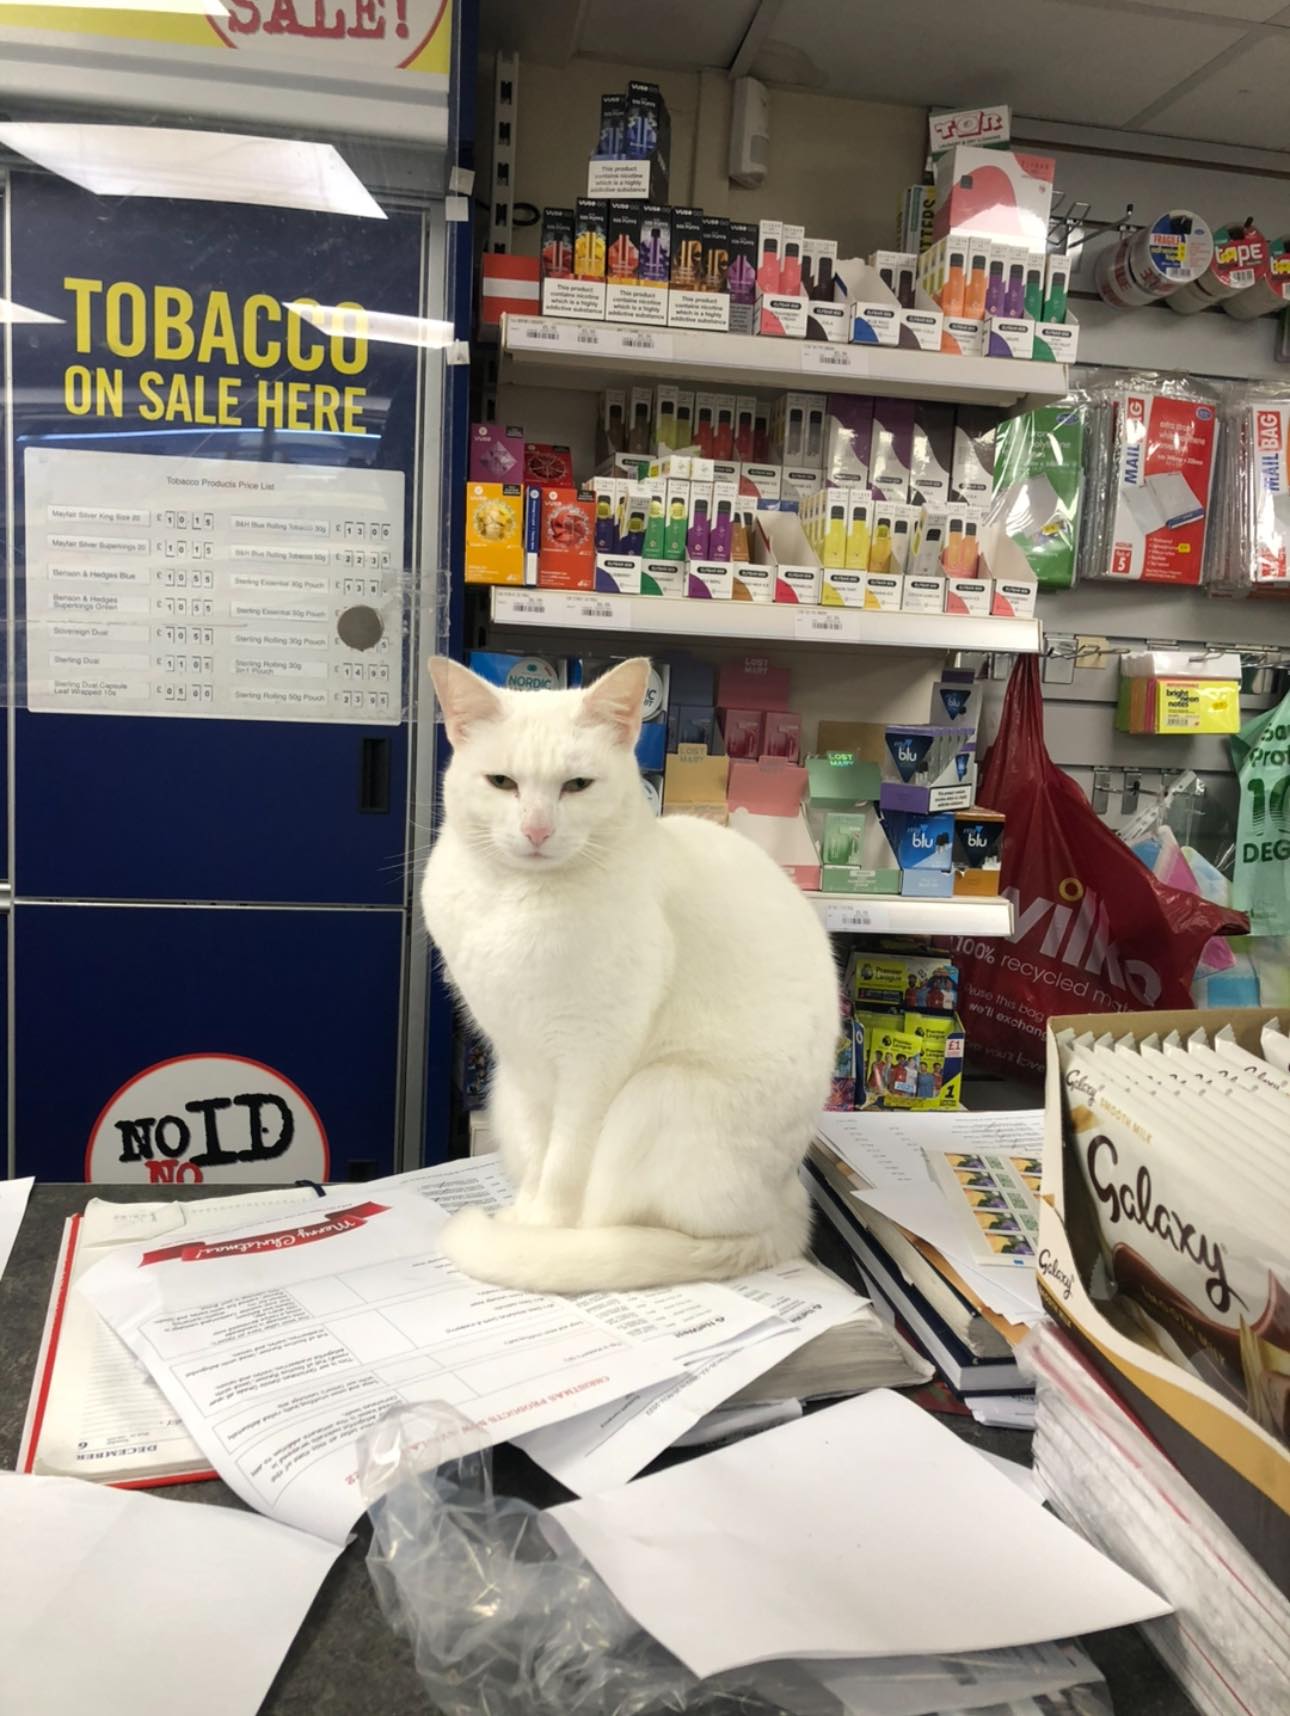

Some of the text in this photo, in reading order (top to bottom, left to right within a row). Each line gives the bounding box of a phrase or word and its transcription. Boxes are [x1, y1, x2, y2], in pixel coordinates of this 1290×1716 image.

[227, 0, 409, 40] SALE!
[64, 276, 370, 375] TOBACCO
[64, 364, 367, 433] ON SALE HERE
[1260, 412, 1279, 450] BAG
[166, 476, 275, 490] Tobacco Products Price List
[1117, 557, 1127, 572] 5
[509, 675, 553, 690] NORDIC
[898, 748, 918, 763] blu
[912, 832, 934, 849] blu
[967, 832, 988, 848] blu
[1001, 954, 1090, 997] recycled
[114, 1092, 295, 1167] NO ID
[144, 1159, 204, 1184] NO
[196, 1219, 357, 1259] Merry Christmas!
[1087, 1134, 1250, 1314] Galaxy
[1038, 1249, 1075, 1301] Galaxy
[76, 1443, 159, 1461] DECEMBER
[78, 1440, 89, 1451] 6
